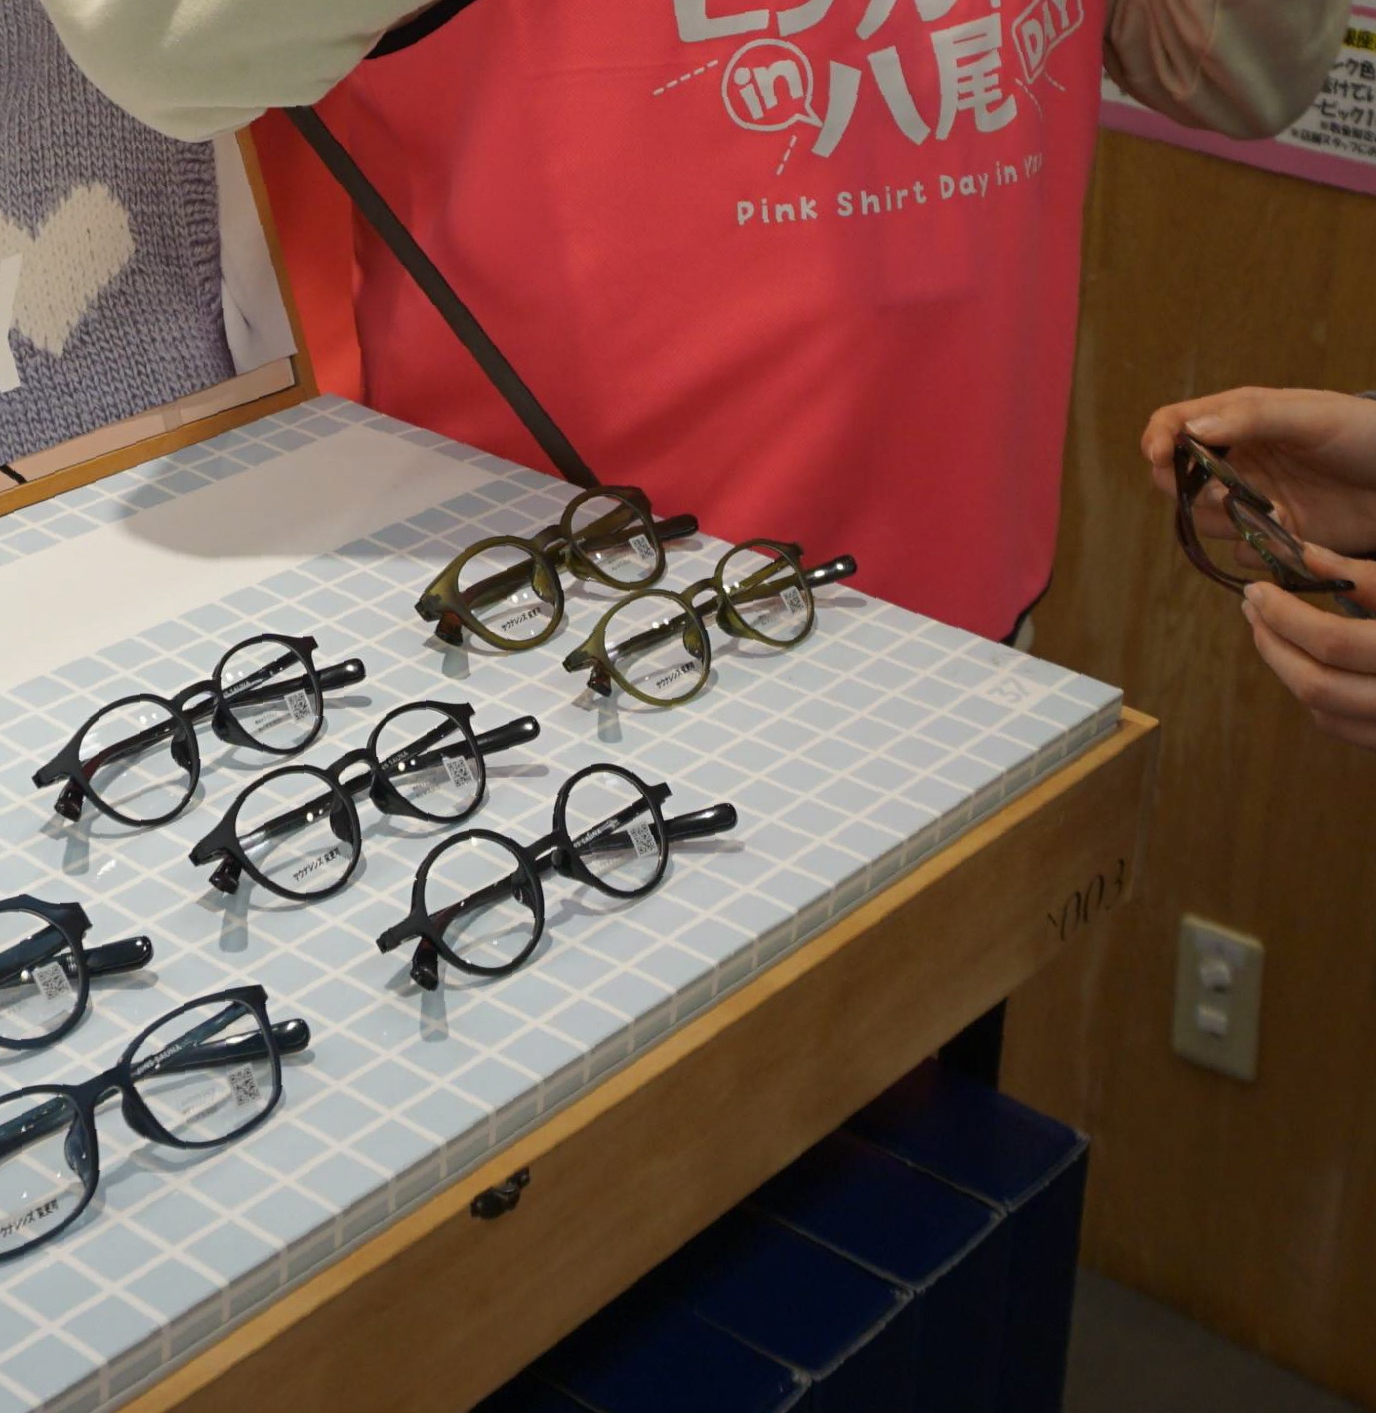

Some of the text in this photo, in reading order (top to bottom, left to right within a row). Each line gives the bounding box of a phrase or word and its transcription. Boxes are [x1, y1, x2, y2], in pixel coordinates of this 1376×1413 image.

[733, 59, 806, 120] in
[811, 12, 1018, 158] 八尾
[836, 179, 928, 218] Shirt
[940, 172, 990, 200] Day
[995, 161, 1018, 185] in
